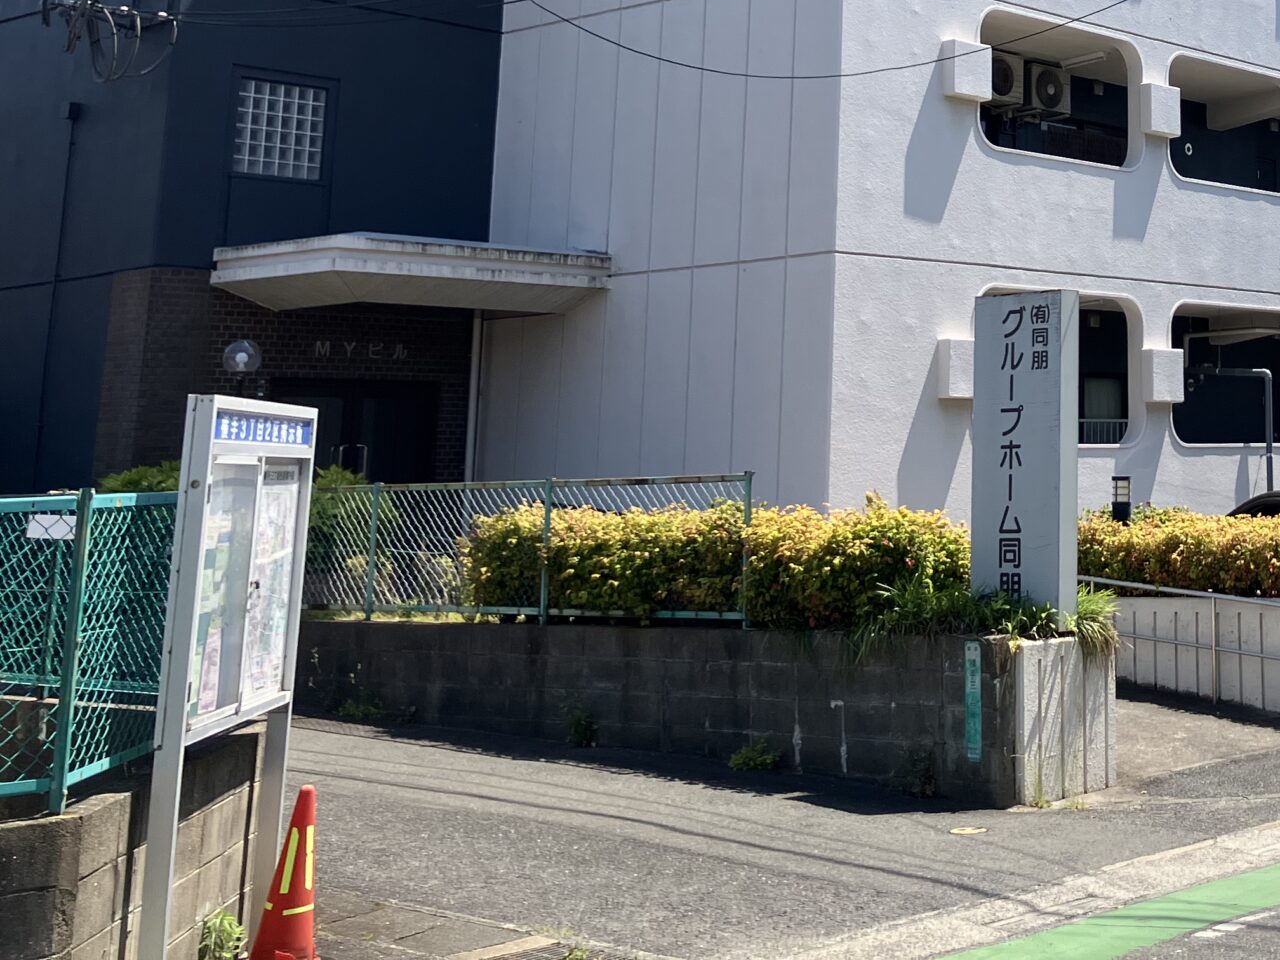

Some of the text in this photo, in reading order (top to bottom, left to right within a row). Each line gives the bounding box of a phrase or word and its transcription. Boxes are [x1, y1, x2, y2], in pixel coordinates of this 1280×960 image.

[999, 305, 1026, 599] グループホーム同朋
